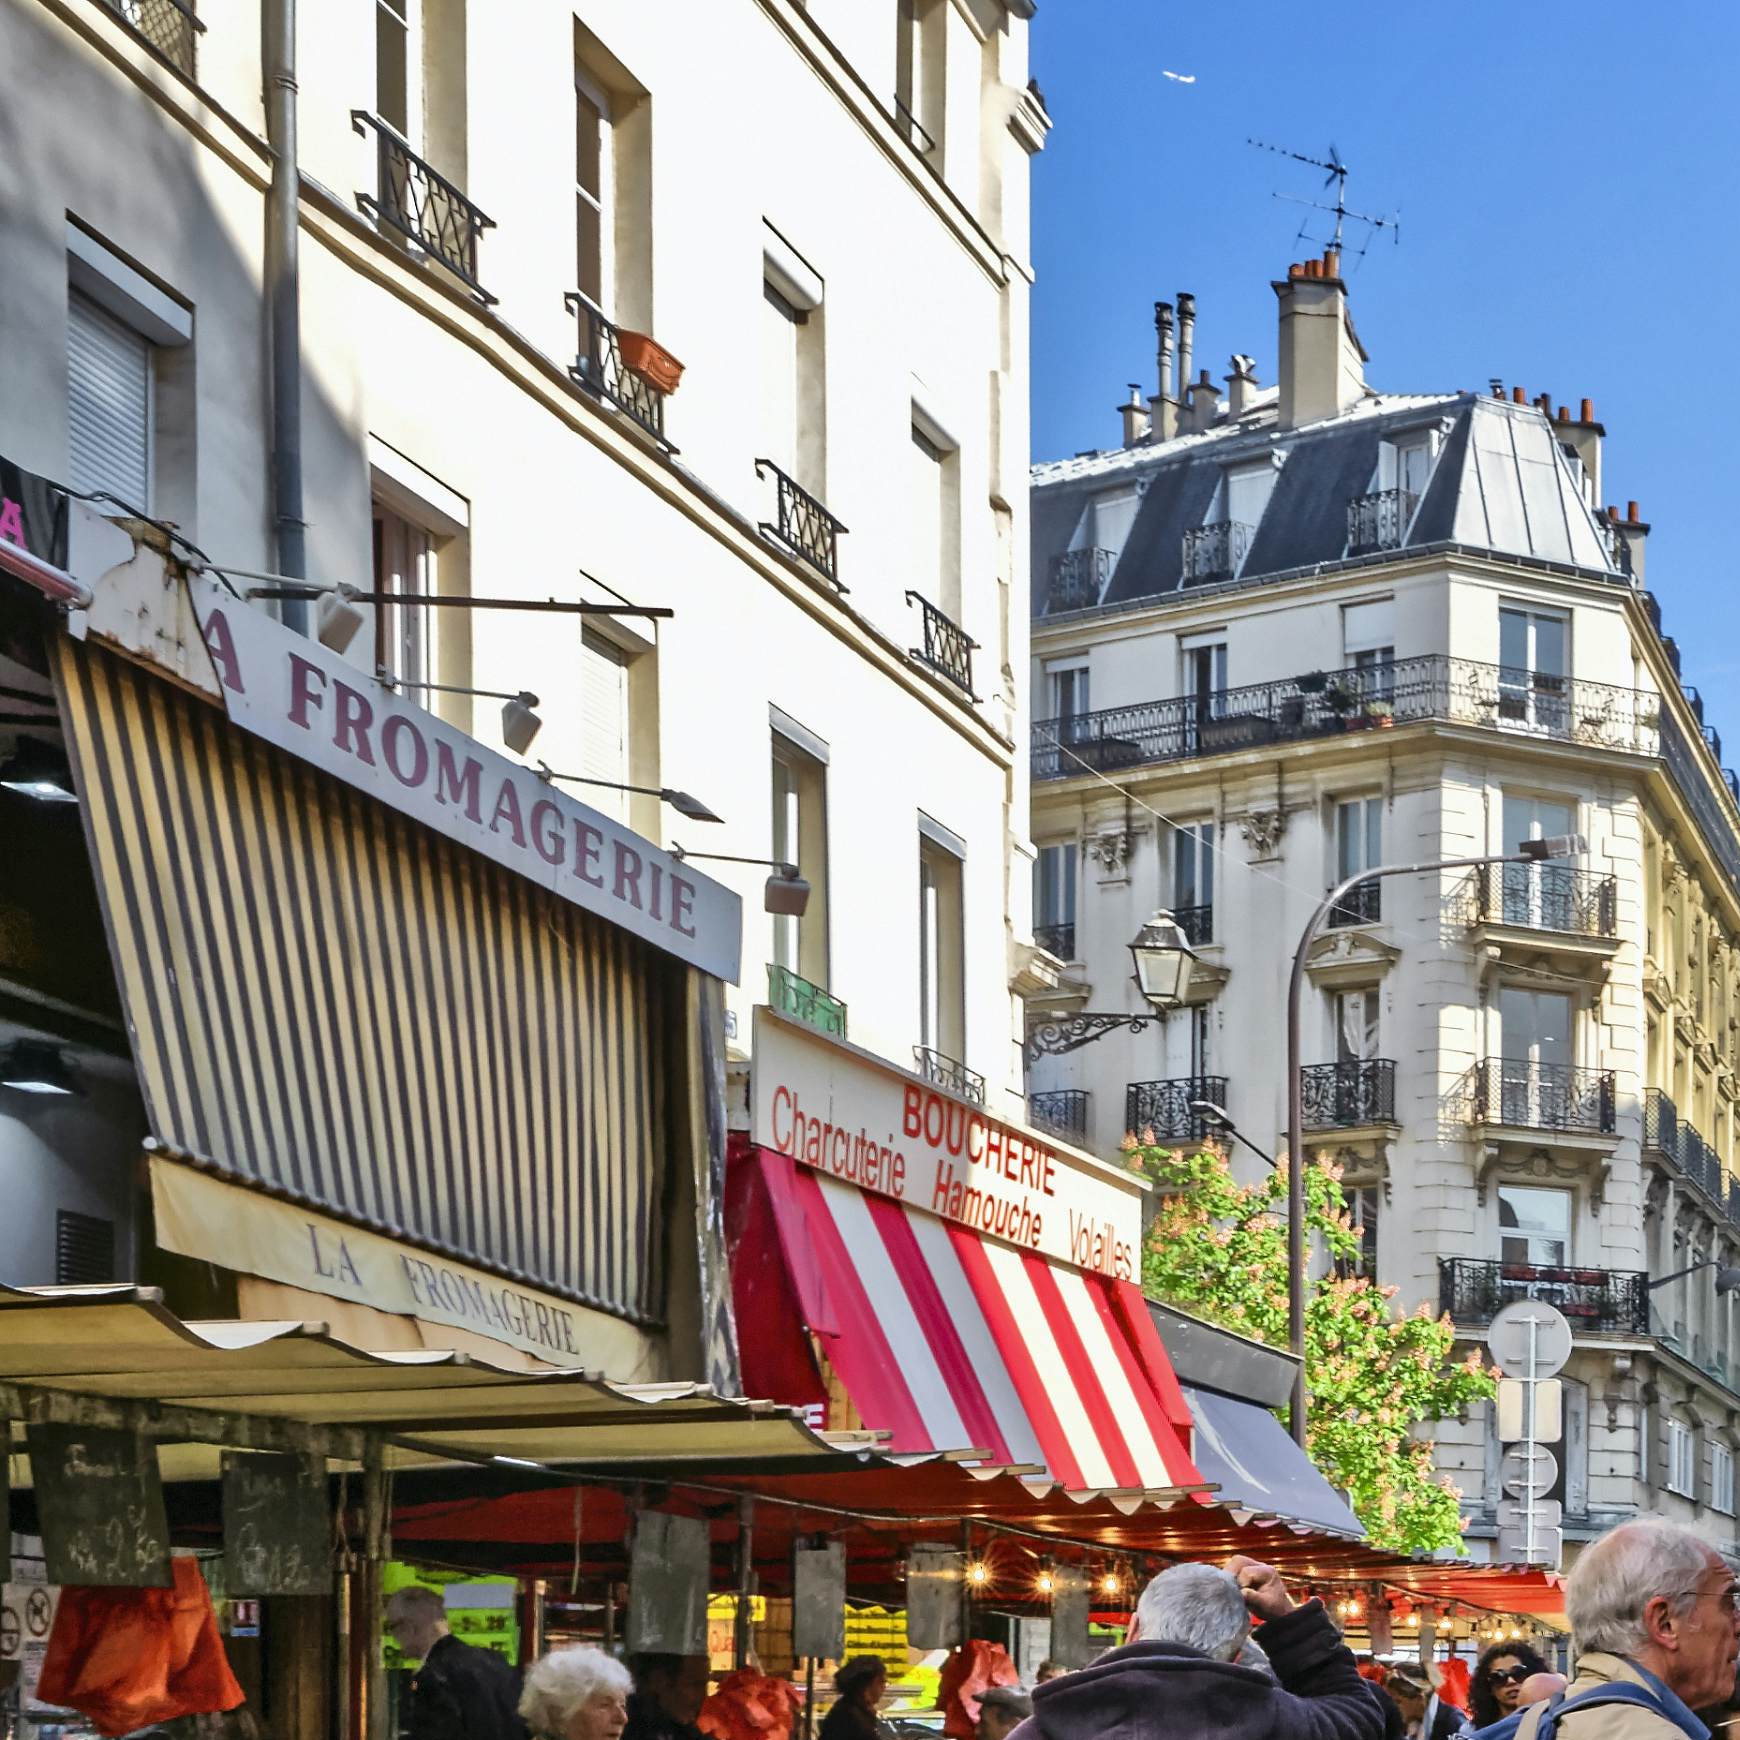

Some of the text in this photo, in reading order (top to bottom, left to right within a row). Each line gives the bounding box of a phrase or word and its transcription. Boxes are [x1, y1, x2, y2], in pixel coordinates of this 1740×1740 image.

[287, 650, 698, 941] FROMAGERIE
[770, 1085, 1133, 1281] Charcuterie Hamouche Volailles
[902, 1082, 1056, 1198] BOUCHERIE
[306, 1222, 581, 1356] LA FROMAGERIE
